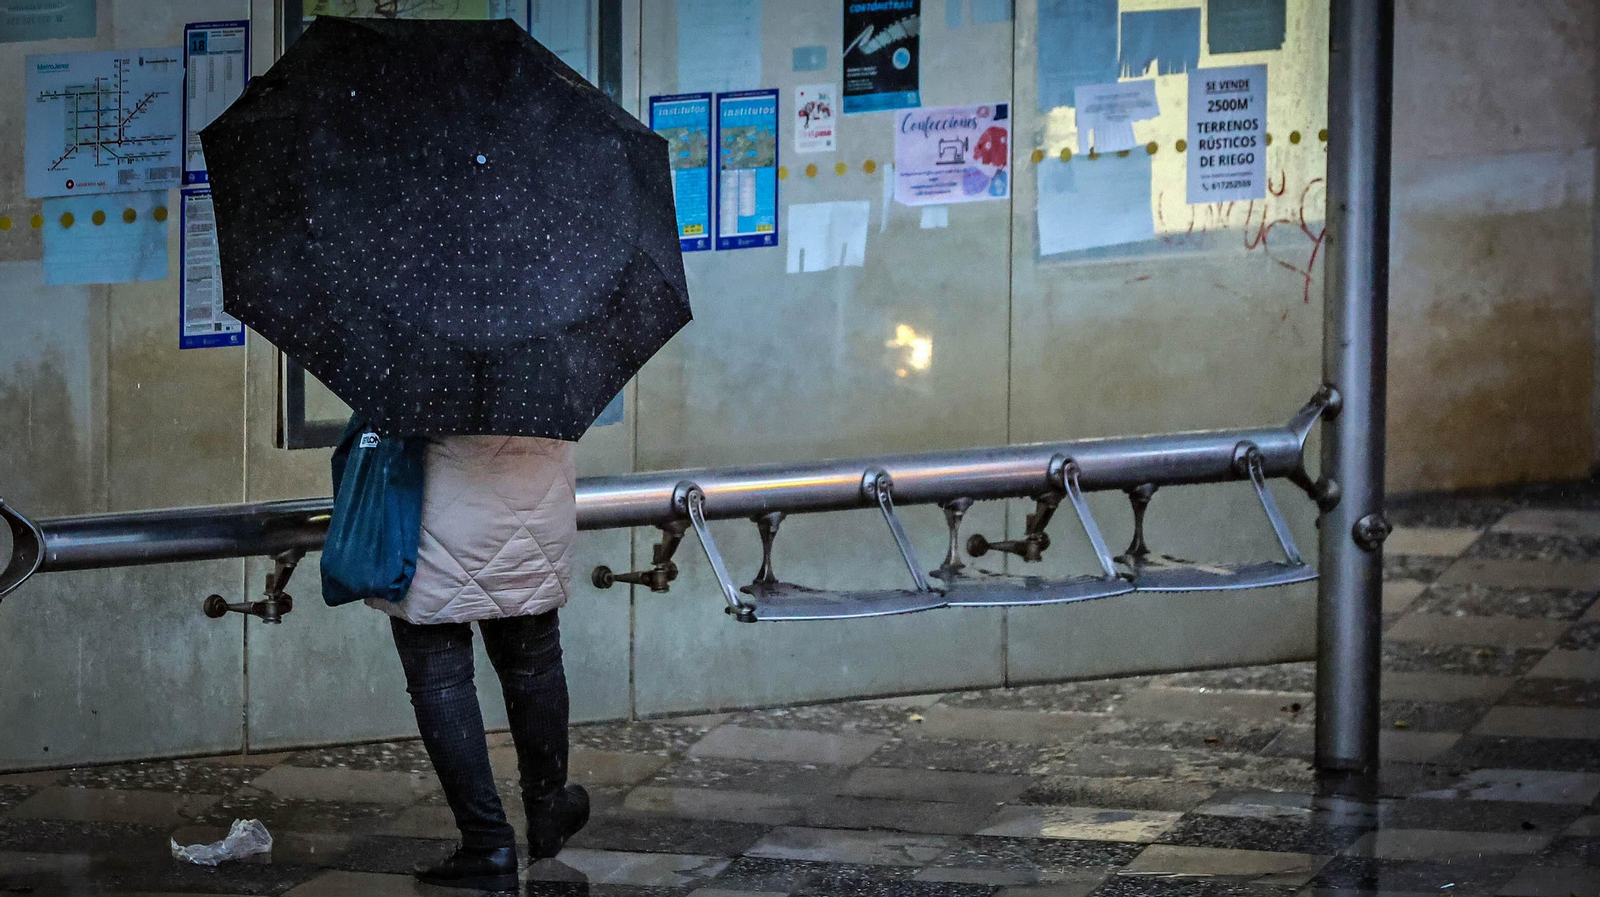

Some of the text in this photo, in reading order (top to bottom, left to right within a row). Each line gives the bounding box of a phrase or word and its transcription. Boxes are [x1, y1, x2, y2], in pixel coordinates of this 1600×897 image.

[192, 40, 205, 52] 18
[1206, 79, 1250, 91] SE VENDE
[658, 105, 706, 116] institutos
[723, 106, 776, 117] institutos
[901, 112, 978, 138] Confecciones
[1197, 118, 1259, 134] TERRENOS
[1199, 135, 1257, 150] RÚSTICOS
[1200, 152, 1255, 168] DE RIEGO
